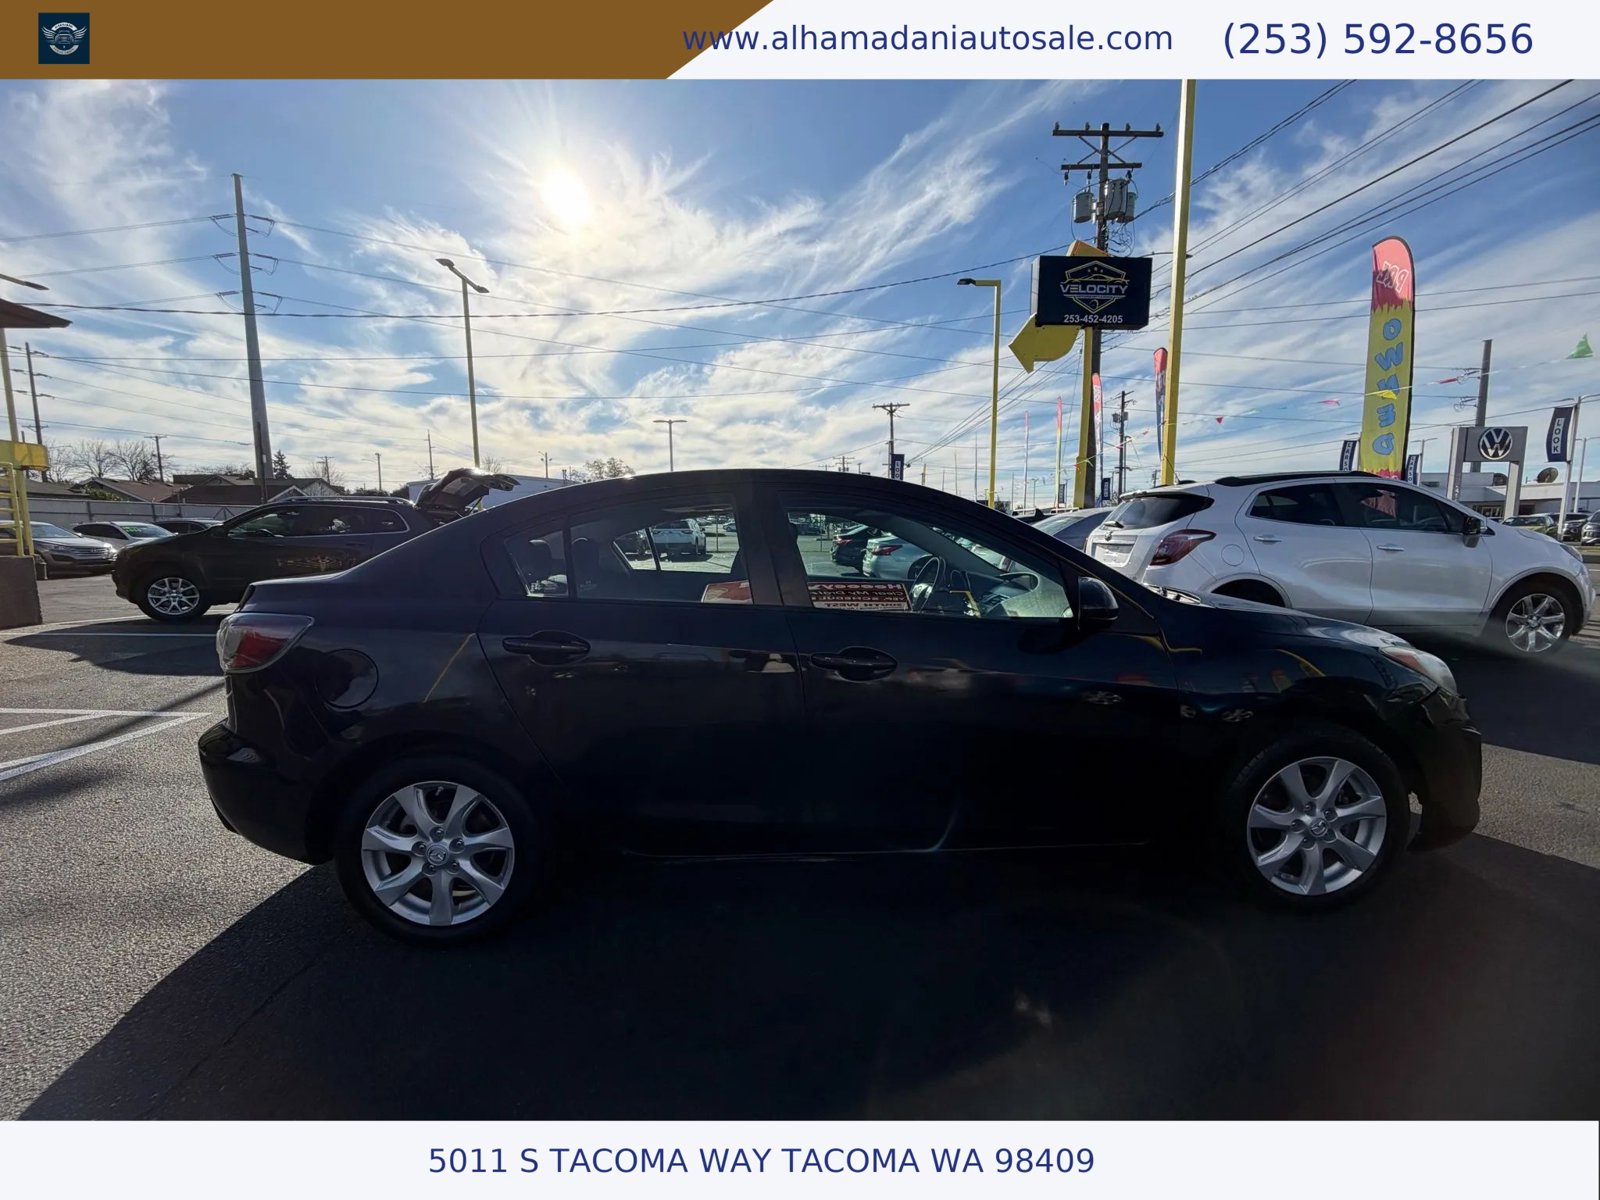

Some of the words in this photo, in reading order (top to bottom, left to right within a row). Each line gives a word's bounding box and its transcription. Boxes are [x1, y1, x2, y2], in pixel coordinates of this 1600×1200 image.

[1060, 284, 1128, 294] VELOCITY
[1063, 314, 1123, 324] 253-452-4205
[1552, 418, 1565, 454] LOOK
